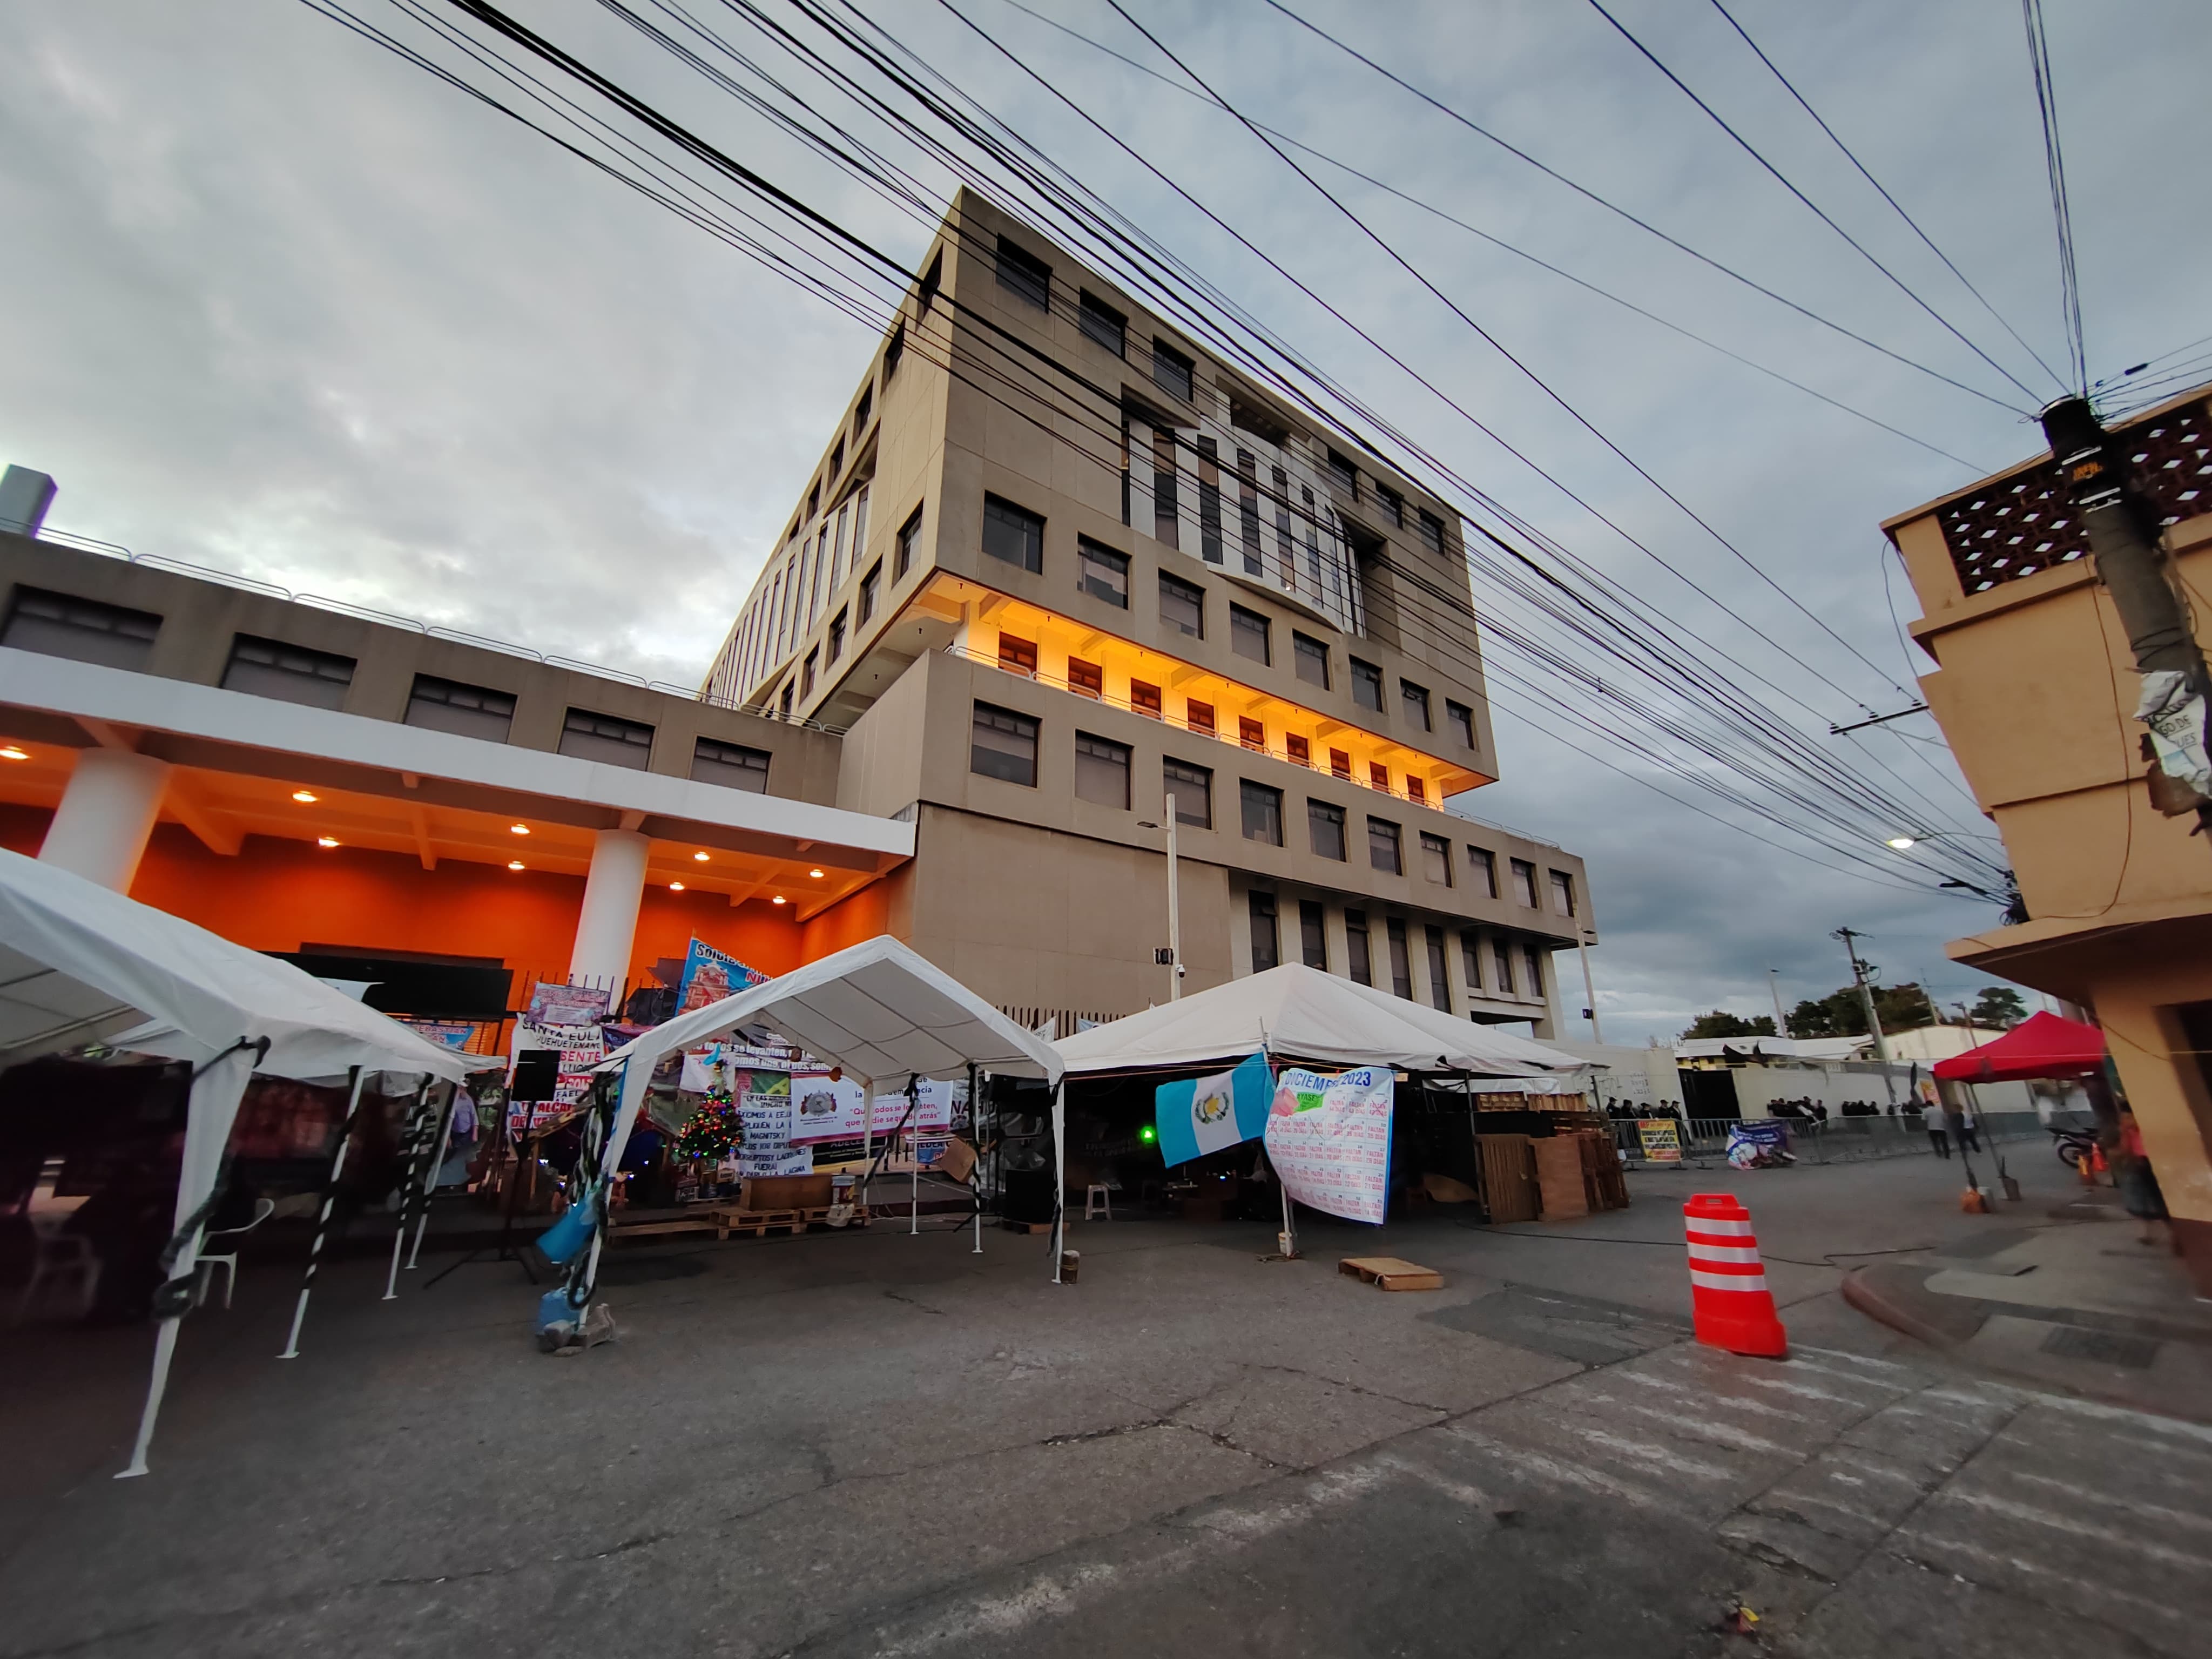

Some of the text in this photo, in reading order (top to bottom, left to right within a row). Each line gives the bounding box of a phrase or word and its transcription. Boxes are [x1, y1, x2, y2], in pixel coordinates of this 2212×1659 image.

[2159, 723, 2175, 736] GO
[2176, 732, 2196, 748] UES
[560, 1051, 601, 1062] SENTE
[1284, 1070, 1371, 1091] DICIEM 2023
[855, 1090, 863, 1098] la
[874, 1105, 893, 1114] odos
[845, 1120, 860, 1128] que
